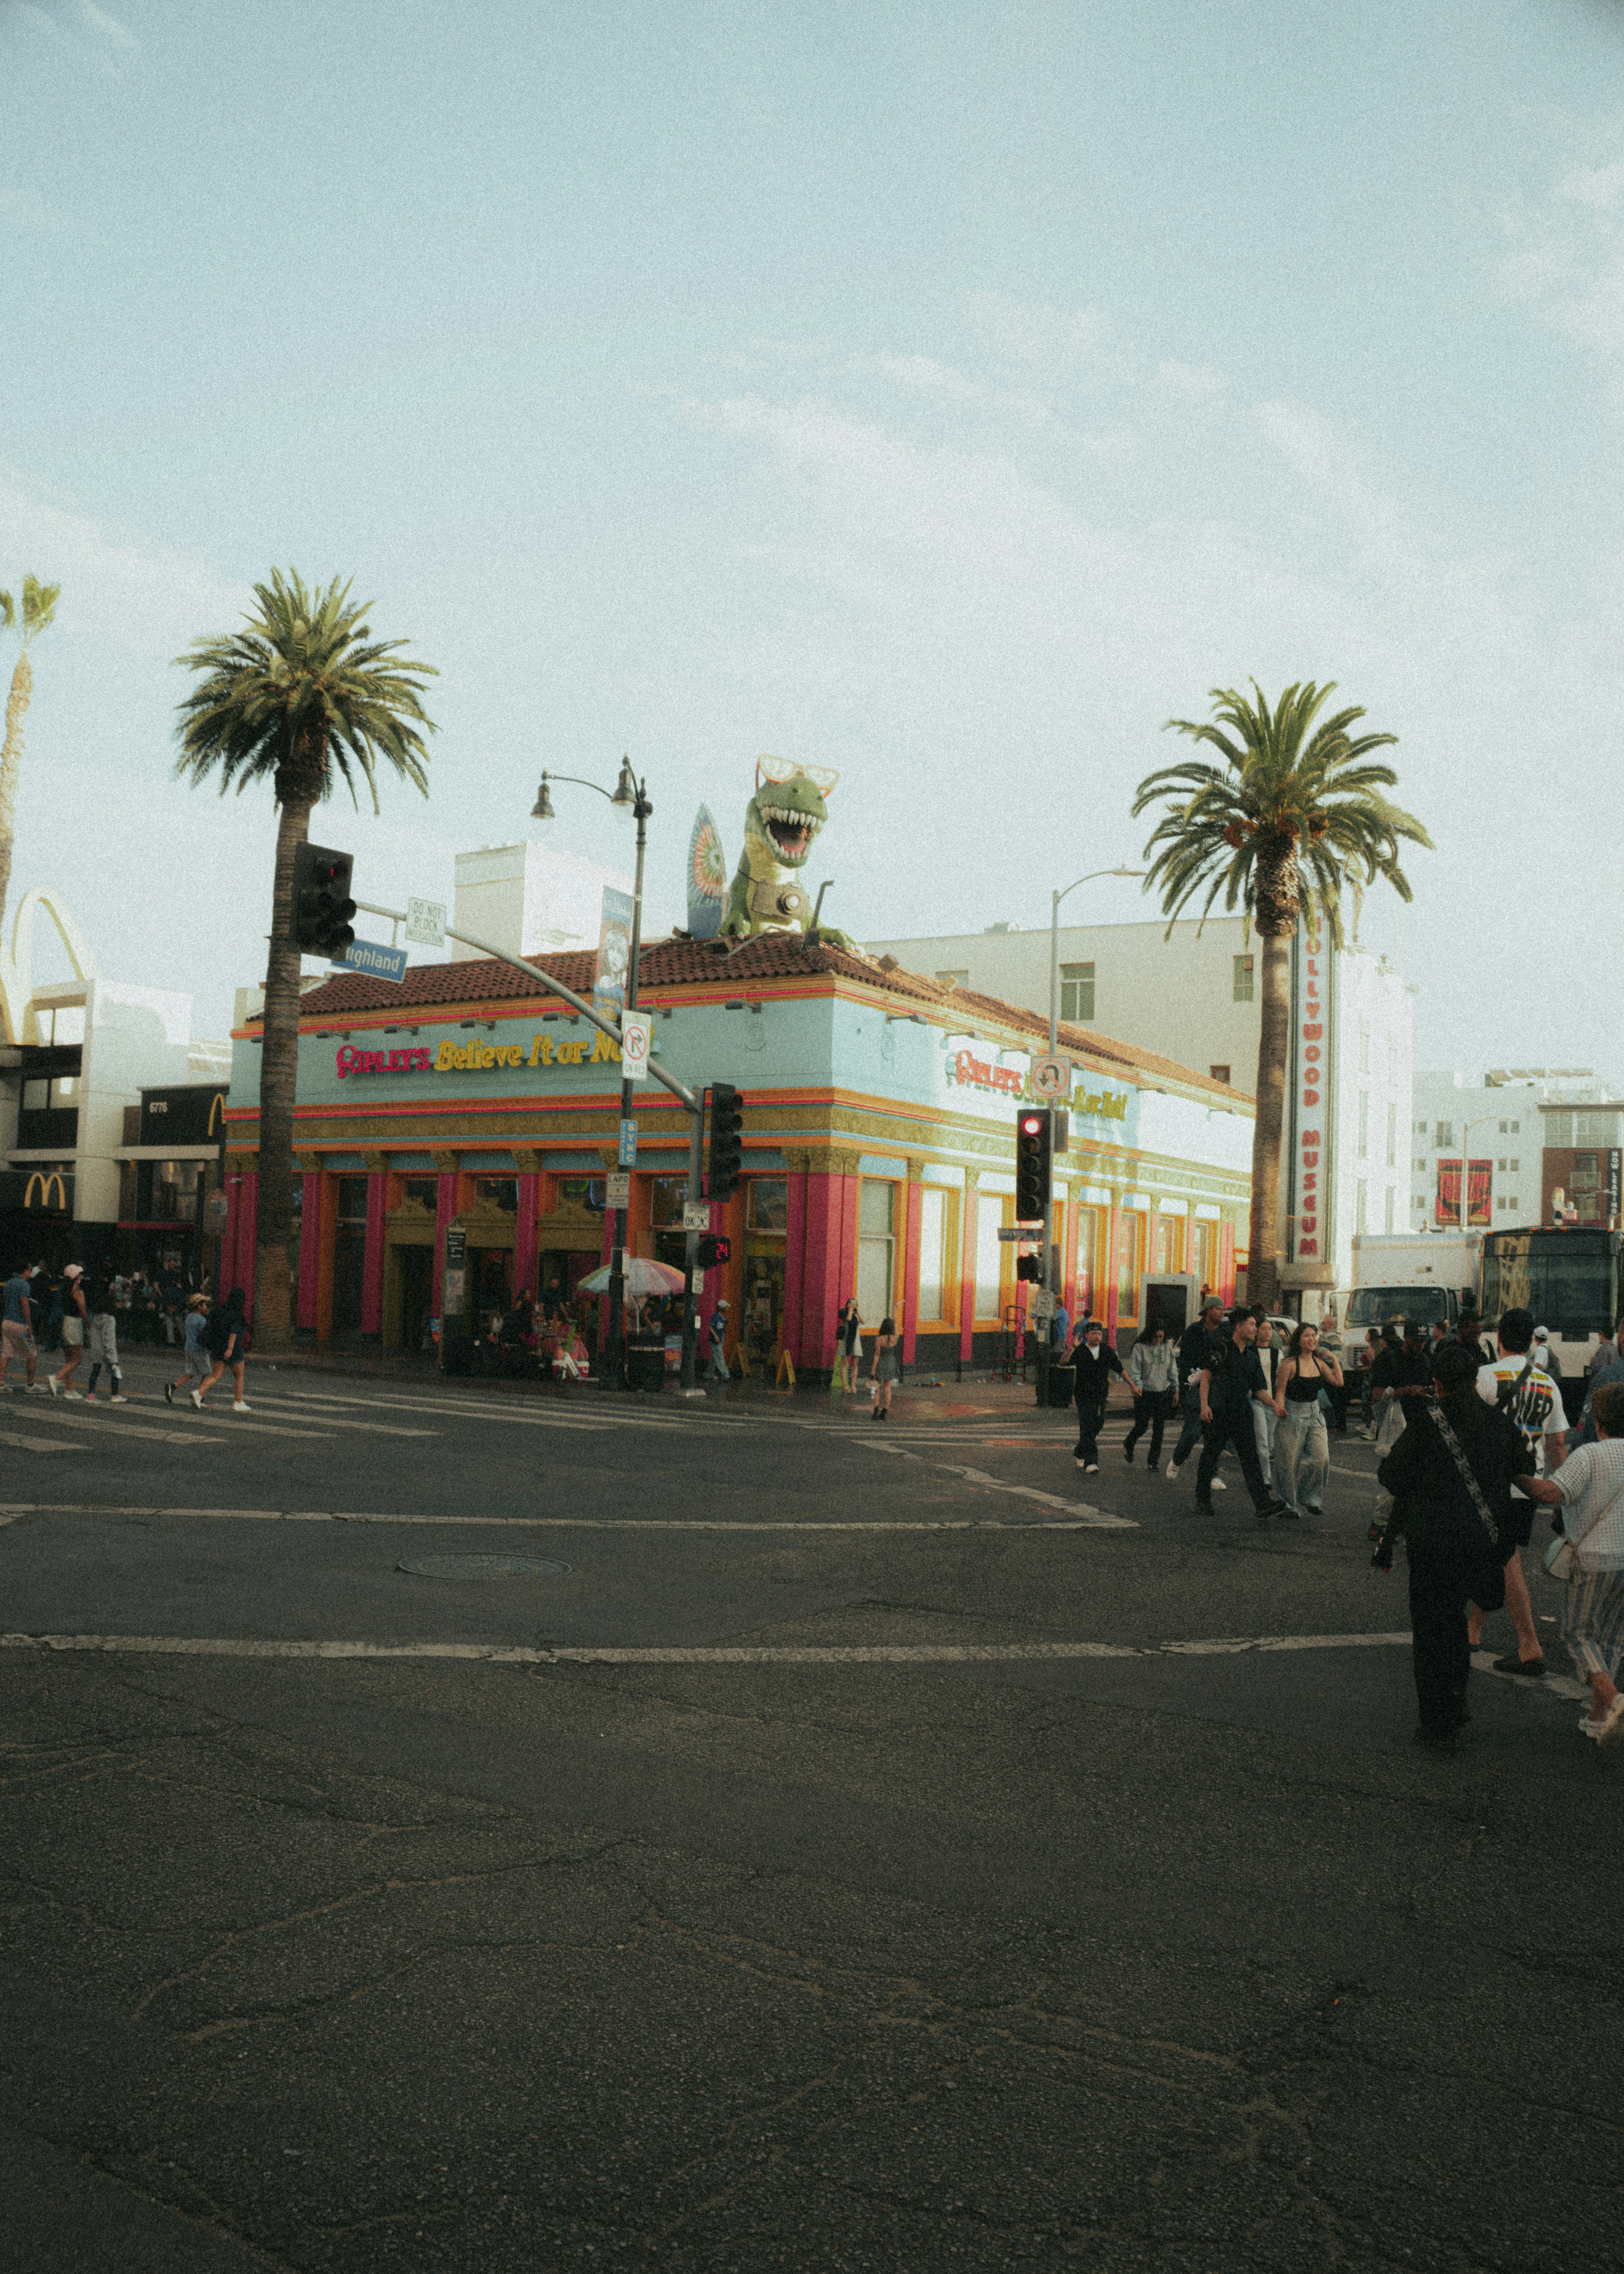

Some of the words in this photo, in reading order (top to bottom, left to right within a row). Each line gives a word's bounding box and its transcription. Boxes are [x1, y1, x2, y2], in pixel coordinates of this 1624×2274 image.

[413, 902, 424, 914] DO
[427, 905, 441, 919] NOT
[413, 916, 438, 932] BLOCK
[336, 1045, 430, 1079] RIPLEY'S
[434, 1038, 523, 1071] Believe
[527, 1035, 554, 1066] It
[557, 1040, 588, 1064] or
[150, 1102, 168, 1113] 6776
[626, 1123, 635, 1162] SYNC
[1299, 1130, 1320, 1256] MUSEUM
[686, 1216, 695, 1227] OK
[716, 1242, 728, 1259] 24
